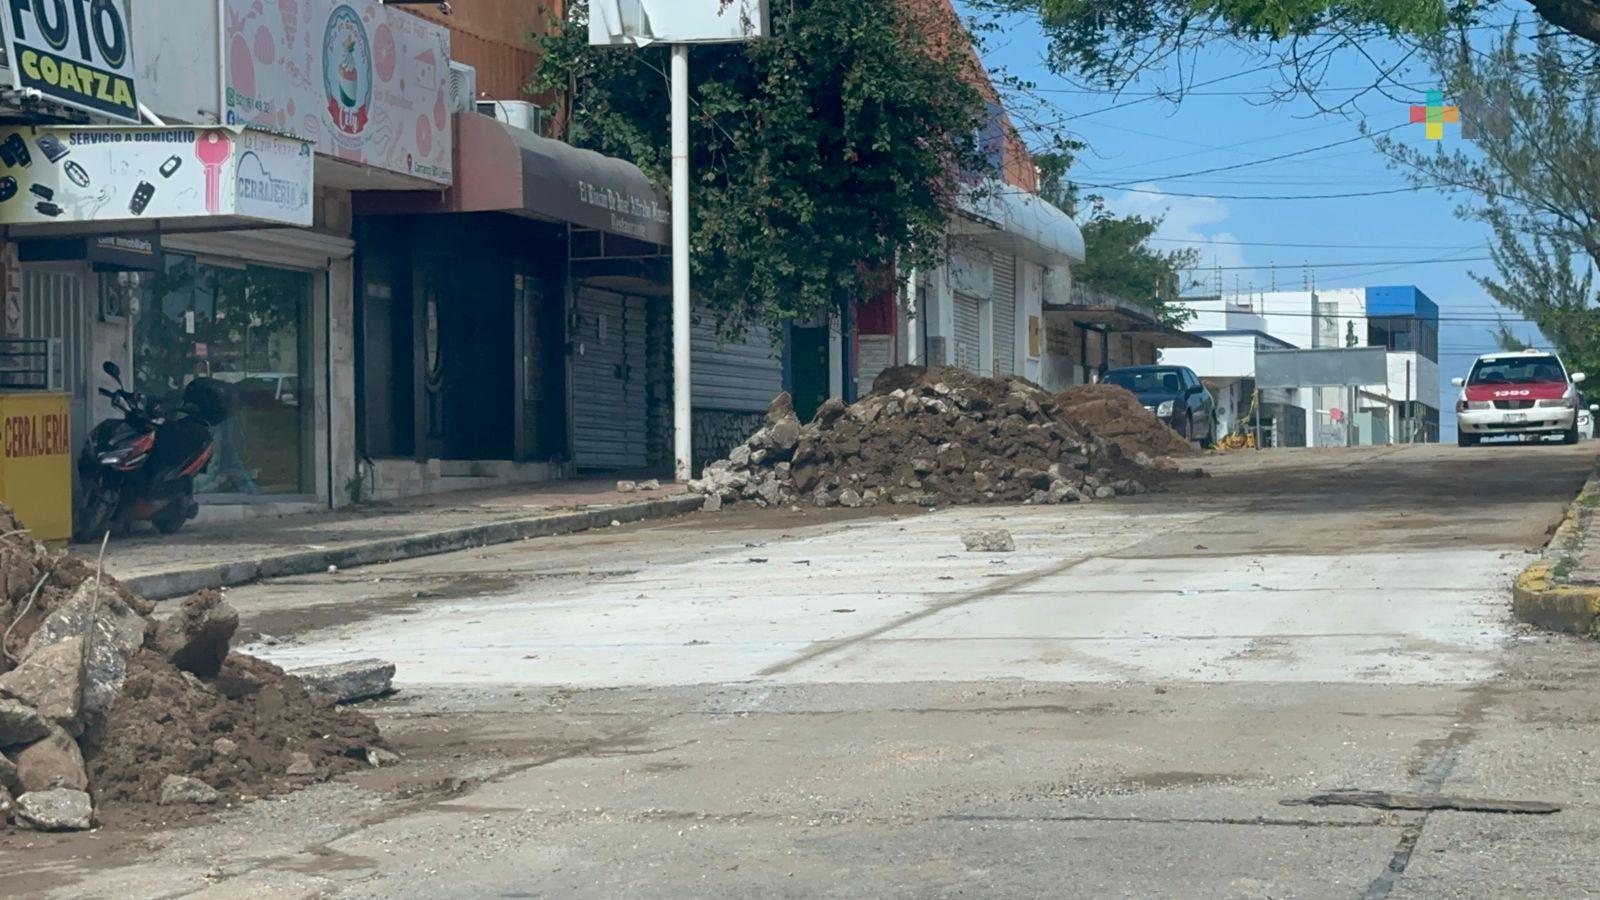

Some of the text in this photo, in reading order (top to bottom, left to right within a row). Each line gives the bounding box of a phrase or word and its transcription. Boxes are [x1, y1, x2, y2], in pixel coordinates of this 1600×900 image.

[9, 0, 126, 69] FOTO
[21, 50, 135, 109] COATZA
[69, 130, 195, 145] SERVICIO A DOMICILIO
[5, 406, 69, 457] CERRAJERÍA
